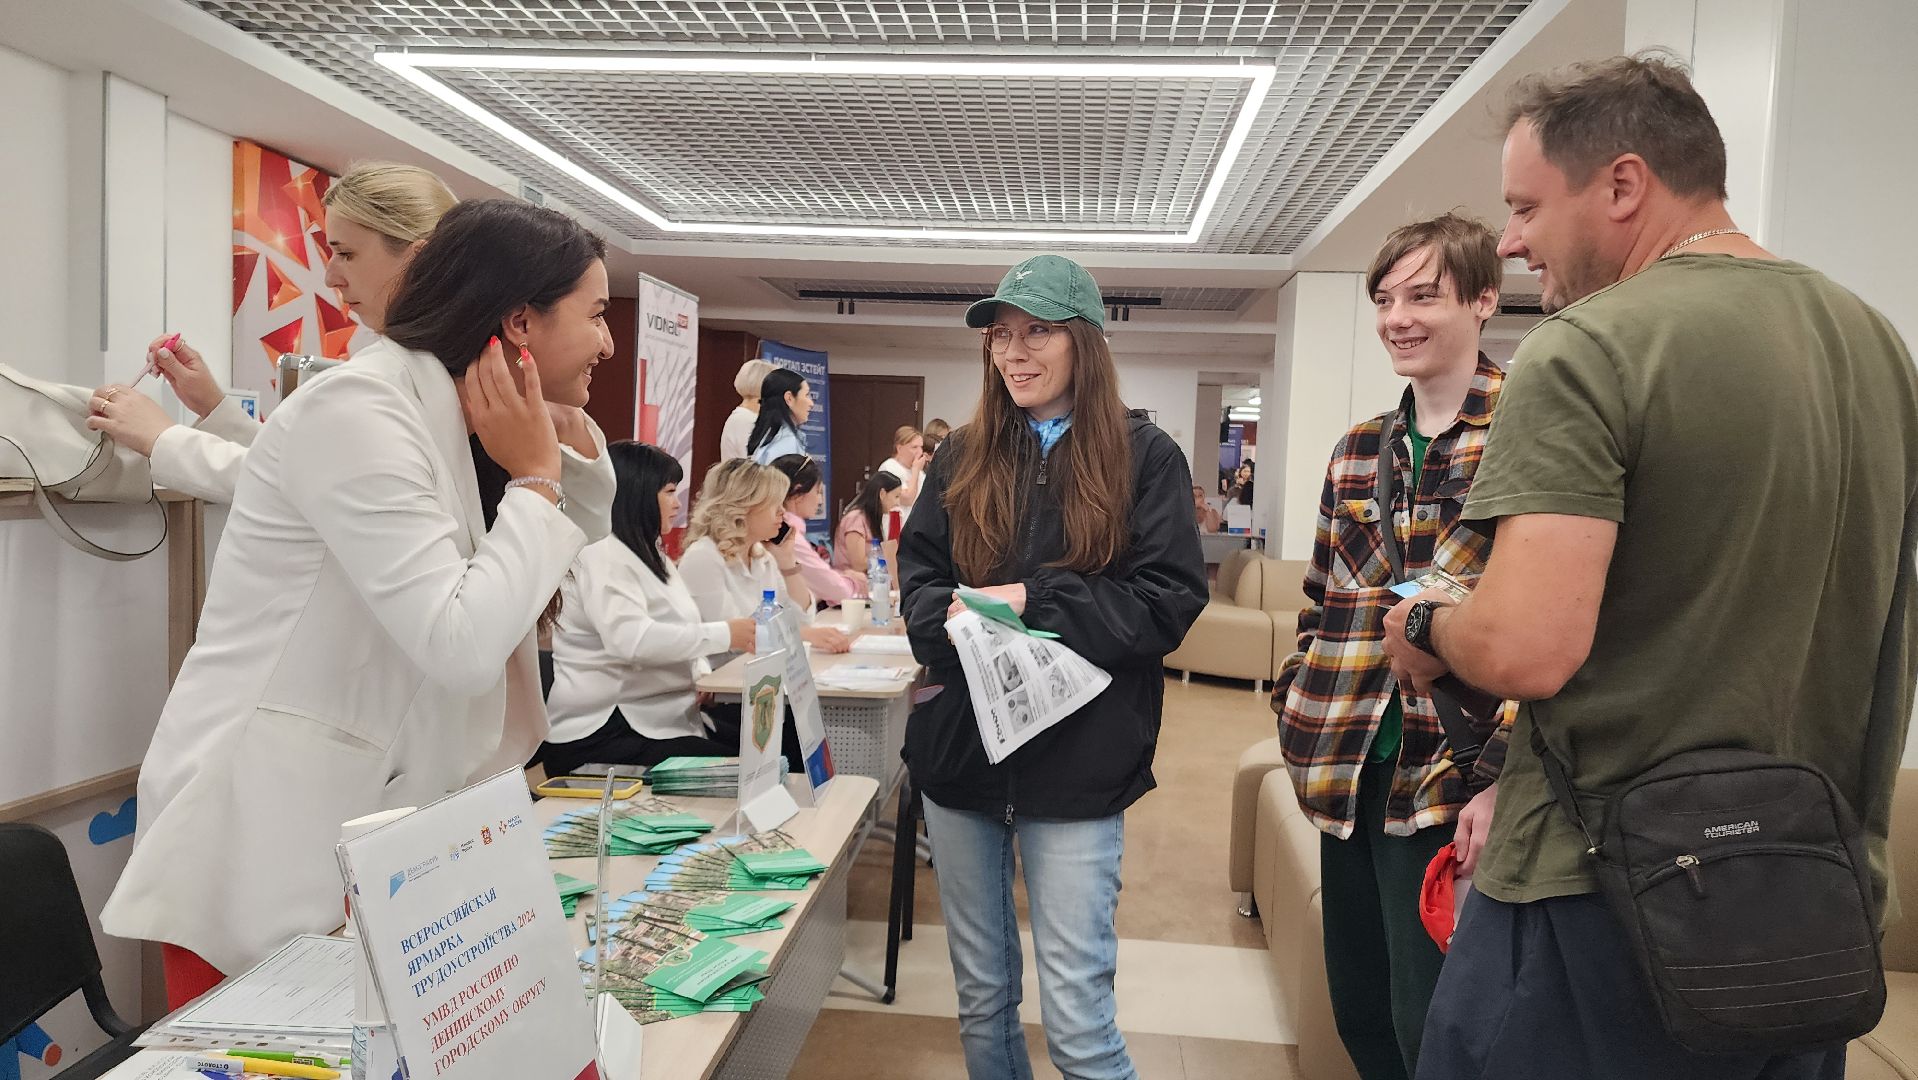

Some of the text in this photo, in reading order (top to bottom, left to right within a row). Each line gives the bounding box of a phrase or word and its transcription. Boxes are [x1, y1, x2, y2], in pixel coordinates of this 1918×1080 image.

[801, 362, 825, 376] ЭСТЕЙТ
[1703, 820, 1759, 833] AMERICAN
[1703, 825, 1760, 839] TOURISTER
[400, 886, 497, 955] ВСЕРОССИЙСКАЯ
[407, 932, 464, 977] ЯРМАРКА
[411, 920, 517, 998] ТРУДОУСТРОЙСТВА
[517, 908, 536, 929] 2024
[422, 954, 519, 1031] УМВД РОССИИ ПО
[431, 985, 506, 1054] ЛЕНИНСКОМУ
[434, 976, 546, 1077] ГОРОДСКОМУ ОКРУГУ
